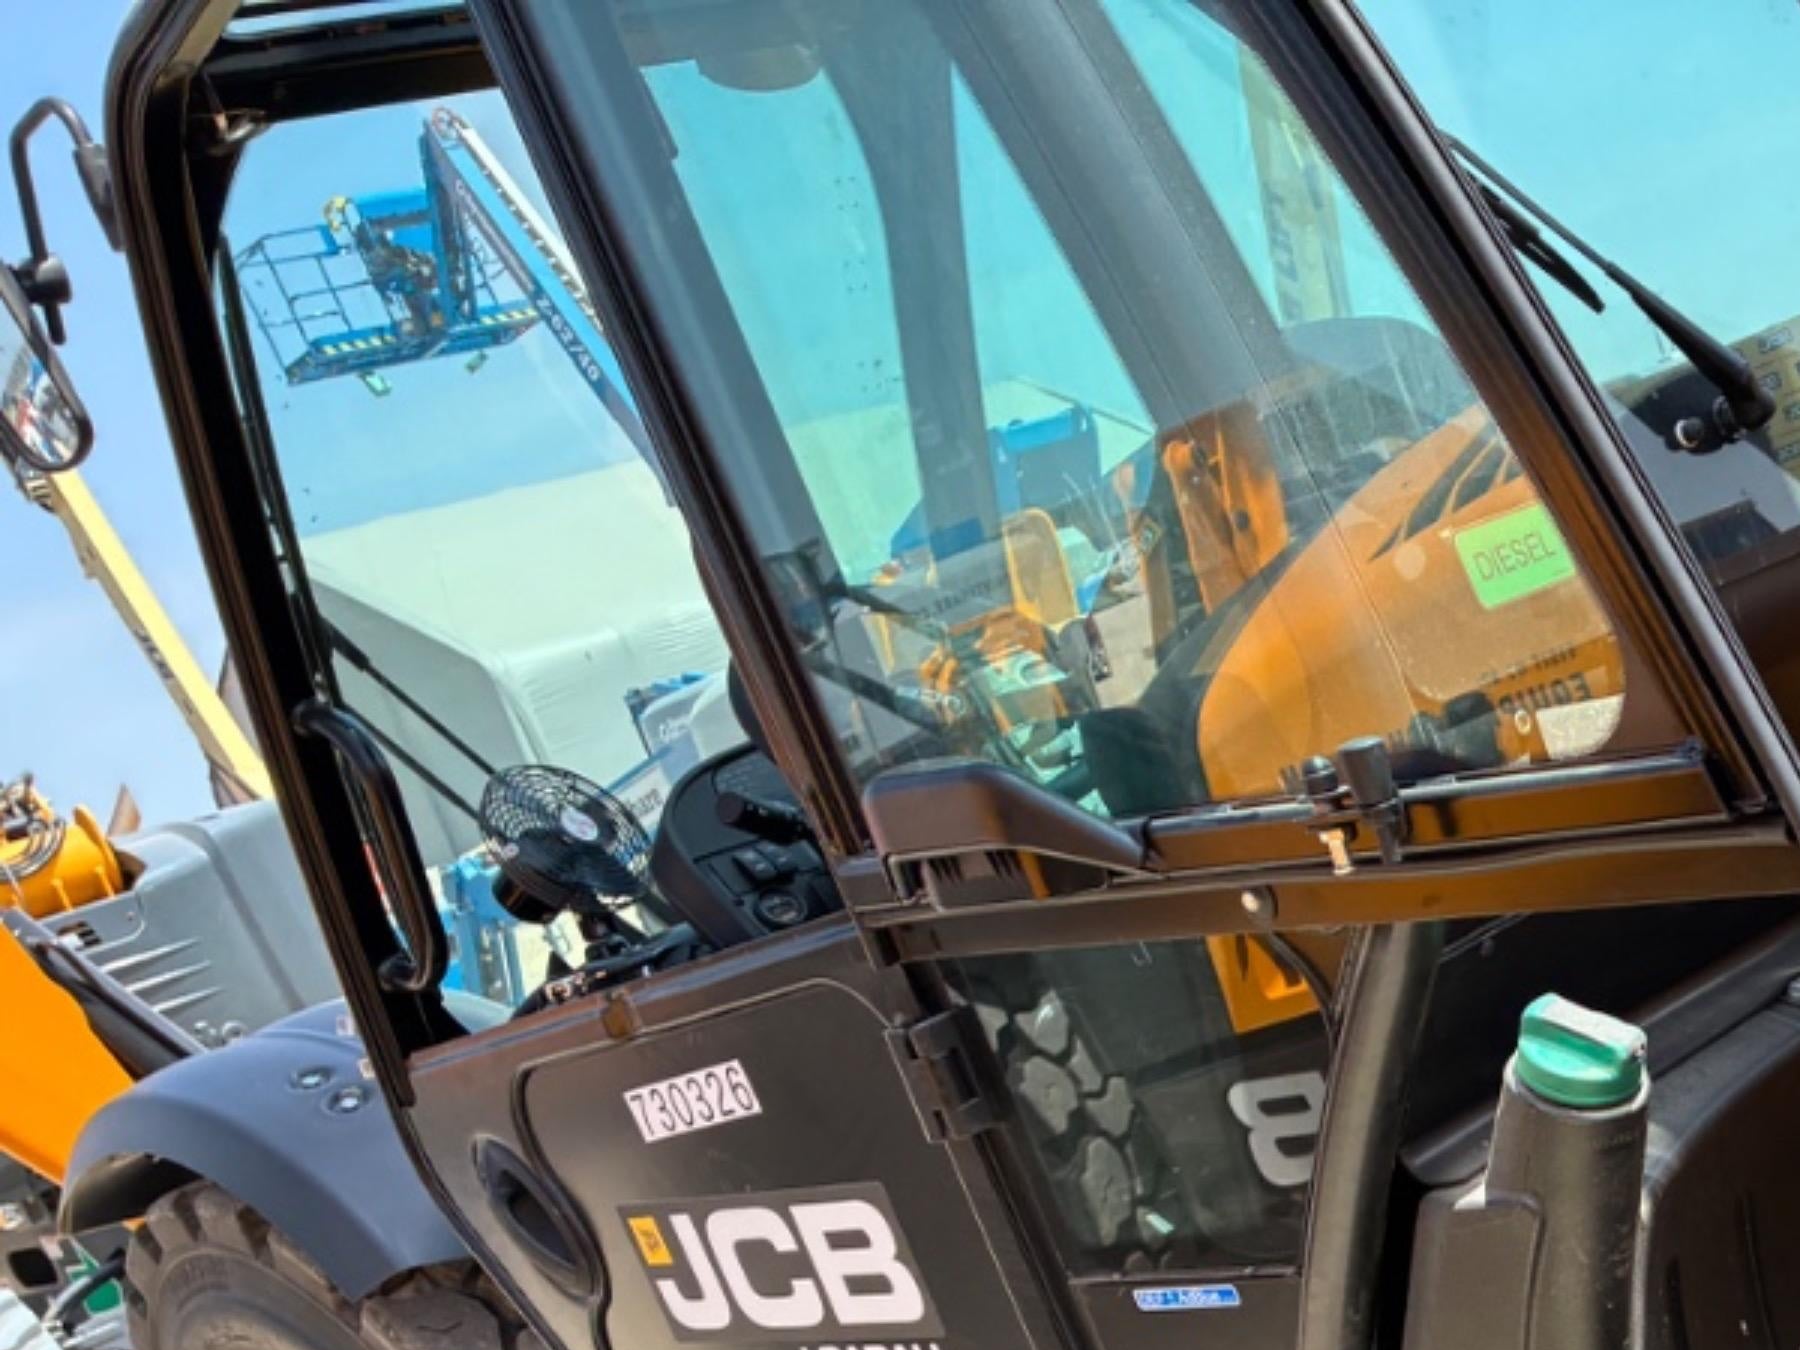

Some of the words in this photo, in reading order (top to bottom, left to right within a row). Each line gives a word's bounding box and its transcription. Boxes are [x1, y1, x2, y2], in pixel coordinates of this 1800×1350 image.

[1473, 531, 1556, 582] DIESEL
[629, 1065, 754, 1137] 730326
[655, 1200, 924, 1330] JCB
